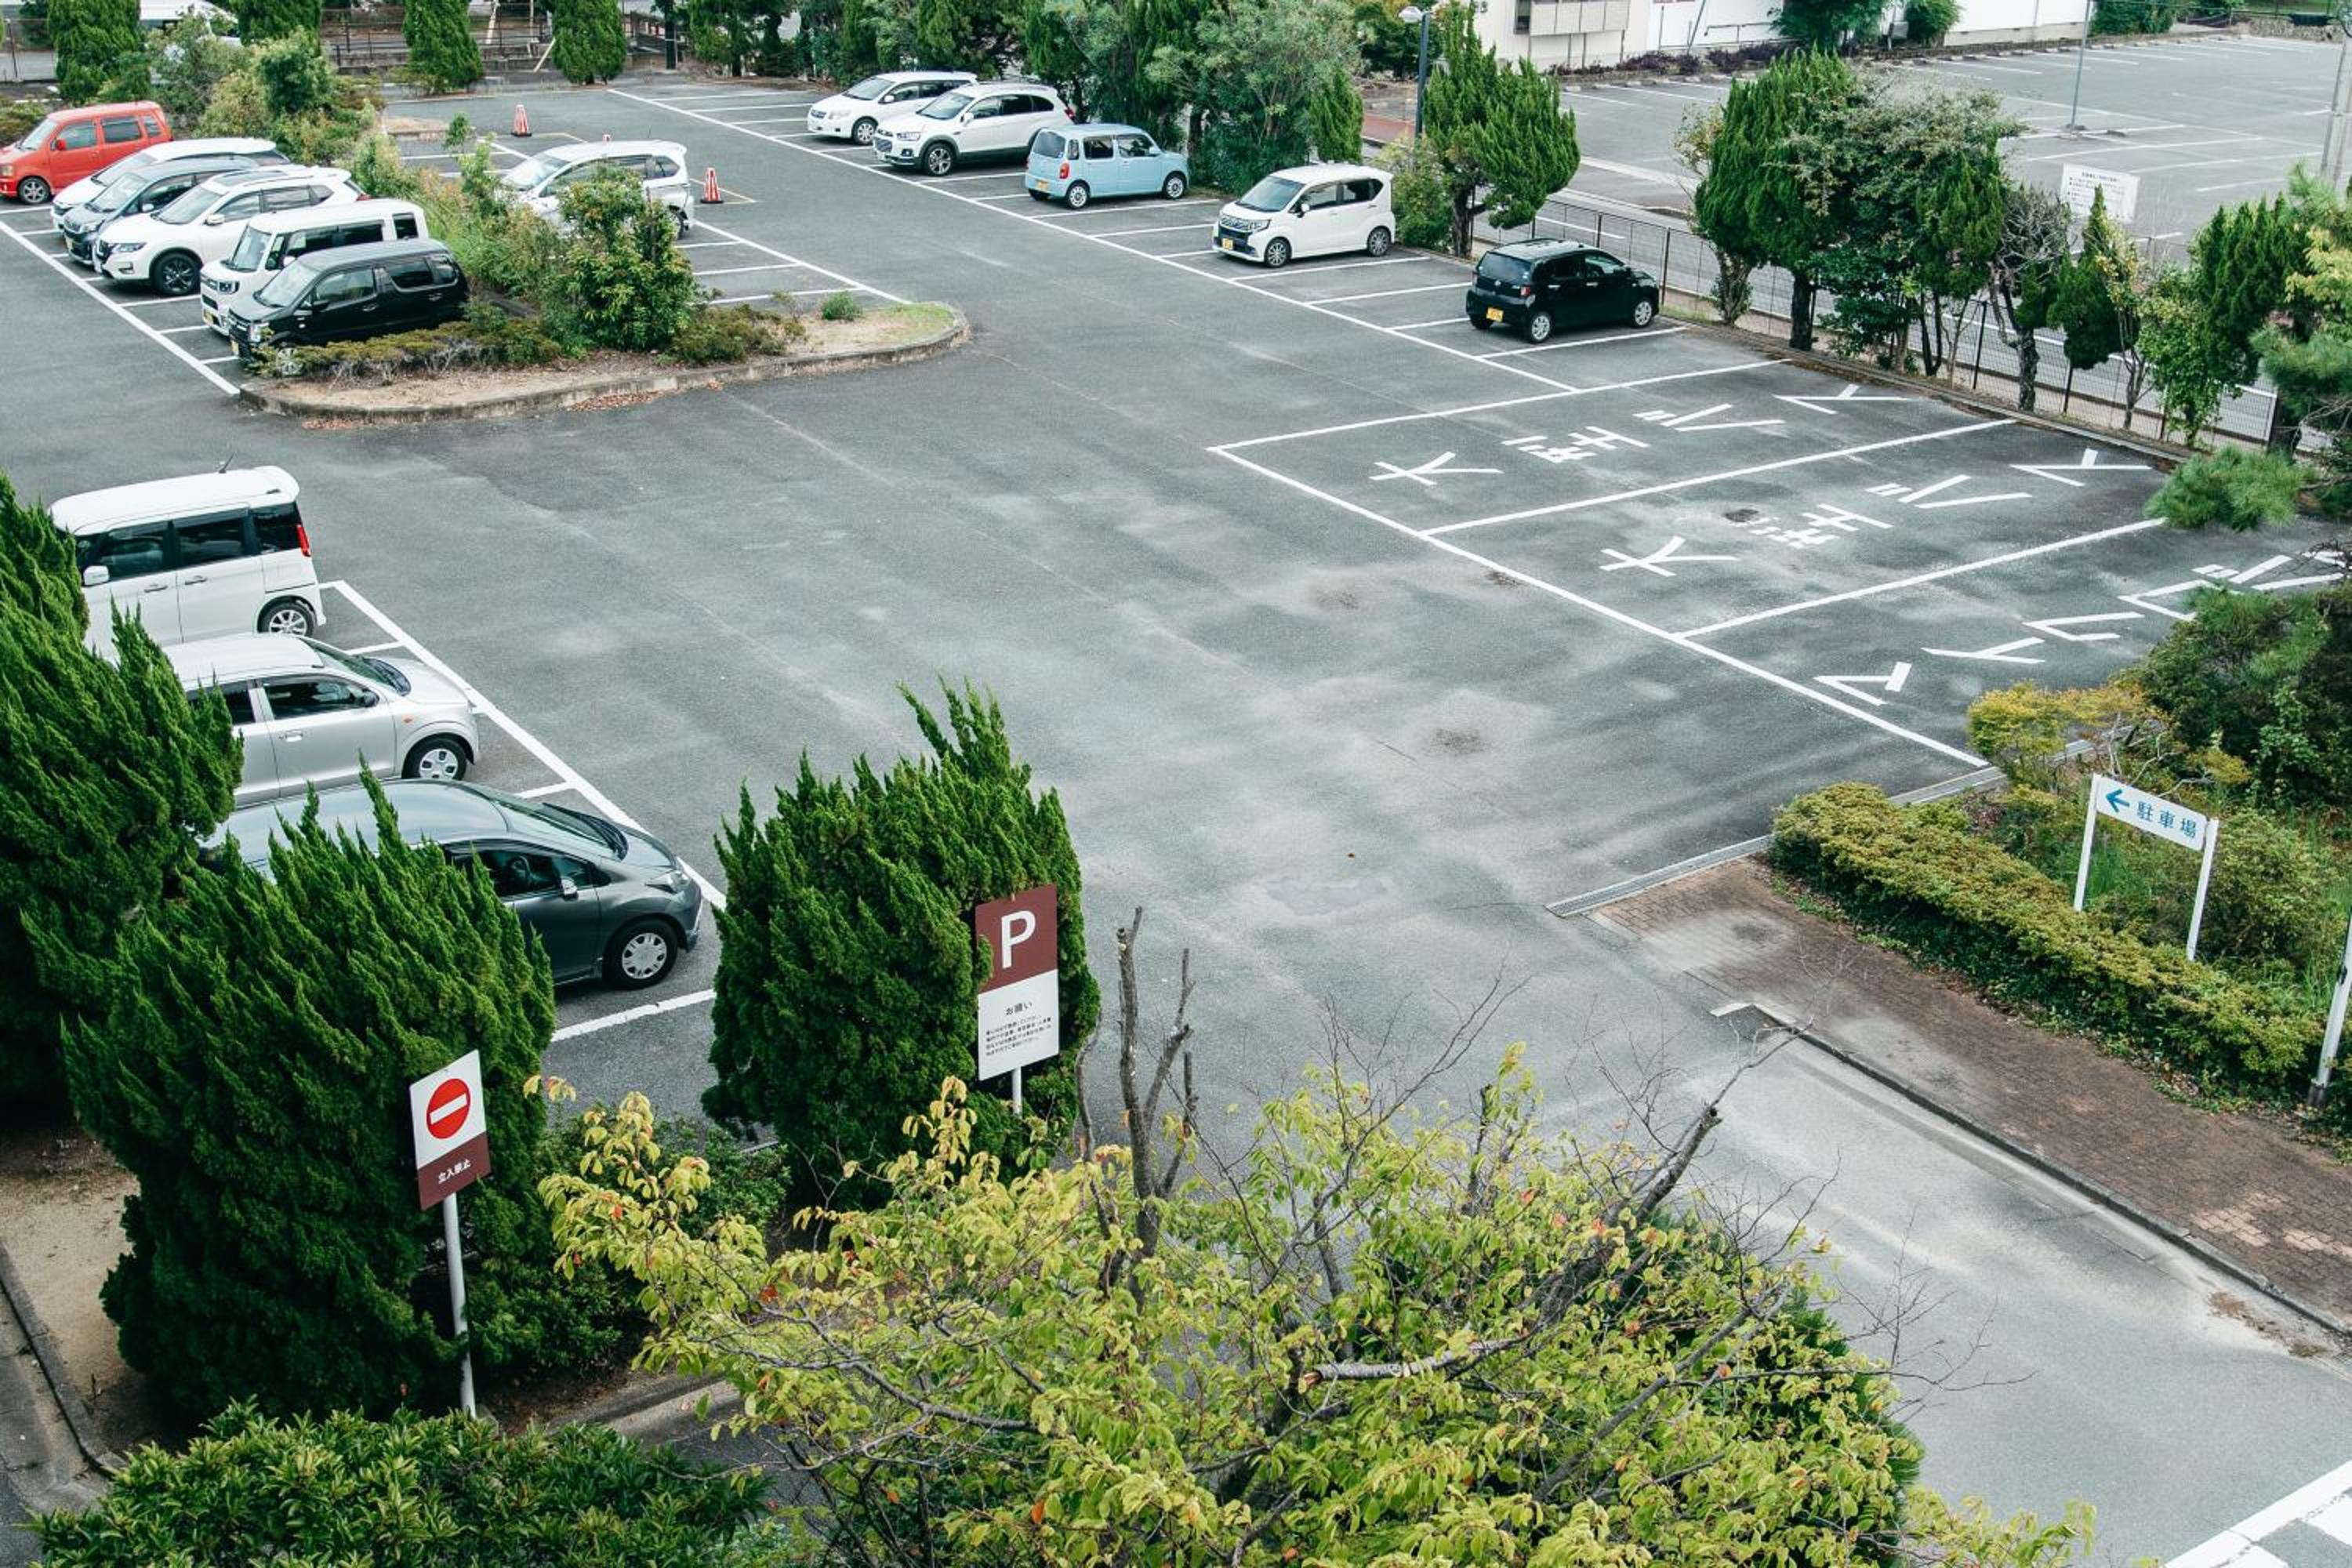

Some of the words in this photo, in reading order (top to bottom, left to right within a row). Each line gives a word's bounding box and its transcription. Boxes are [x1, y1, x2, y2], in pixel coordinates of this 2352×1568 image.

[1369, 383, 1911, 486] 大型バス
[1599, 448, 2152, 577] 大型バス
[2137, 800, 2198, 839] 駐車場
[1001, 910, 1036, 969] P
[1005, 1000, 1033, 1015] お願い
[438, 1159, 472, 1185] 立入禁止
